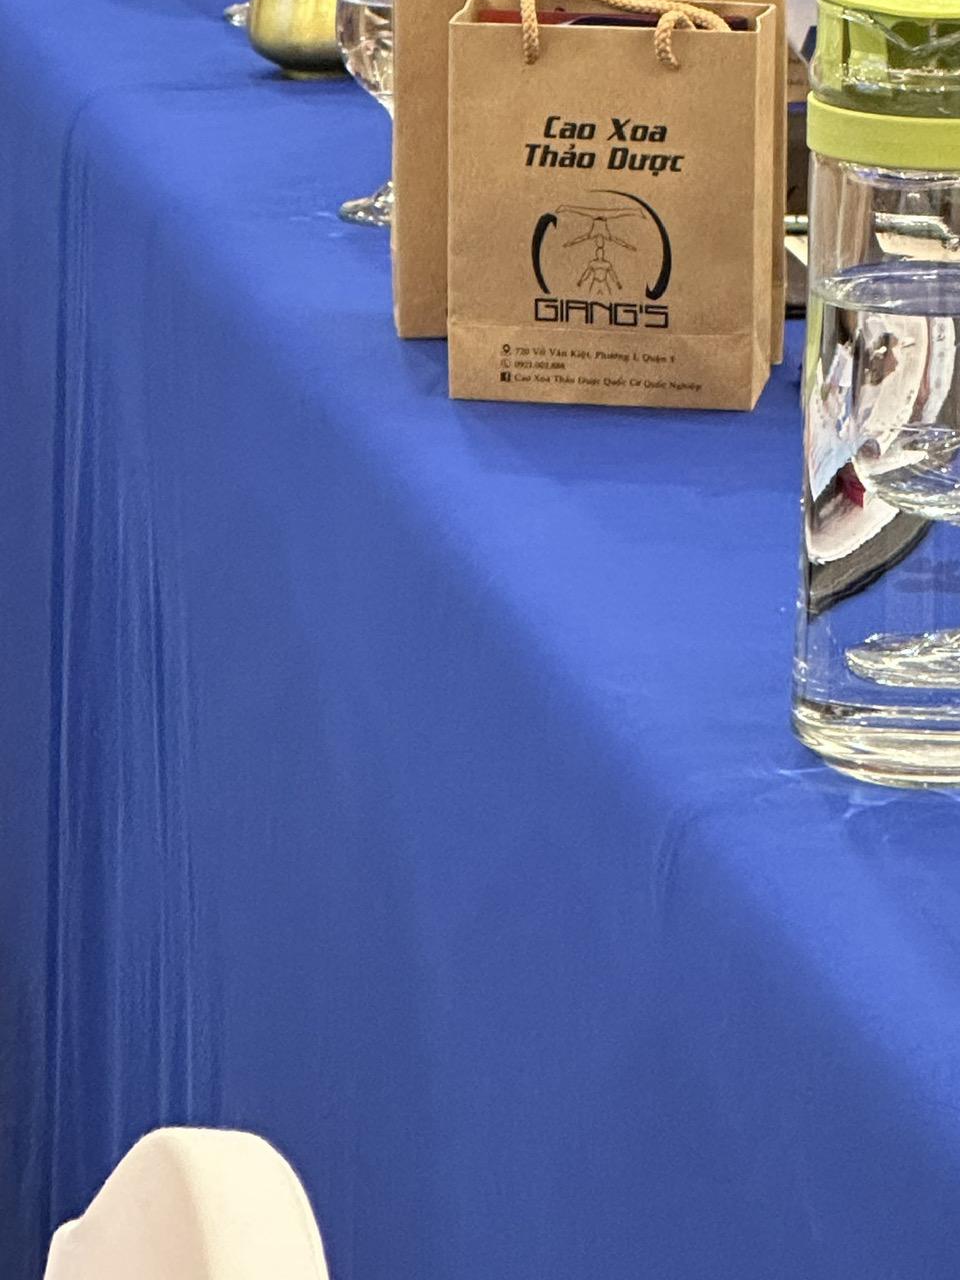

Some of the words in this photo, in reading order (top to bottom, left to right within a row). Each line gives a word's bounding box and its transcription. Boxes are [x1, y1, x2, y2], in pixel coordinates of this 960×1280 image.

[543, 116, 596, 141] Cao
[606, 117, 668, 143] Xoa
[525, 143, 596, 169] Thảo
[606, 147, 685, 177] Dược
[534, 297, 669, 329] GIANG'S
